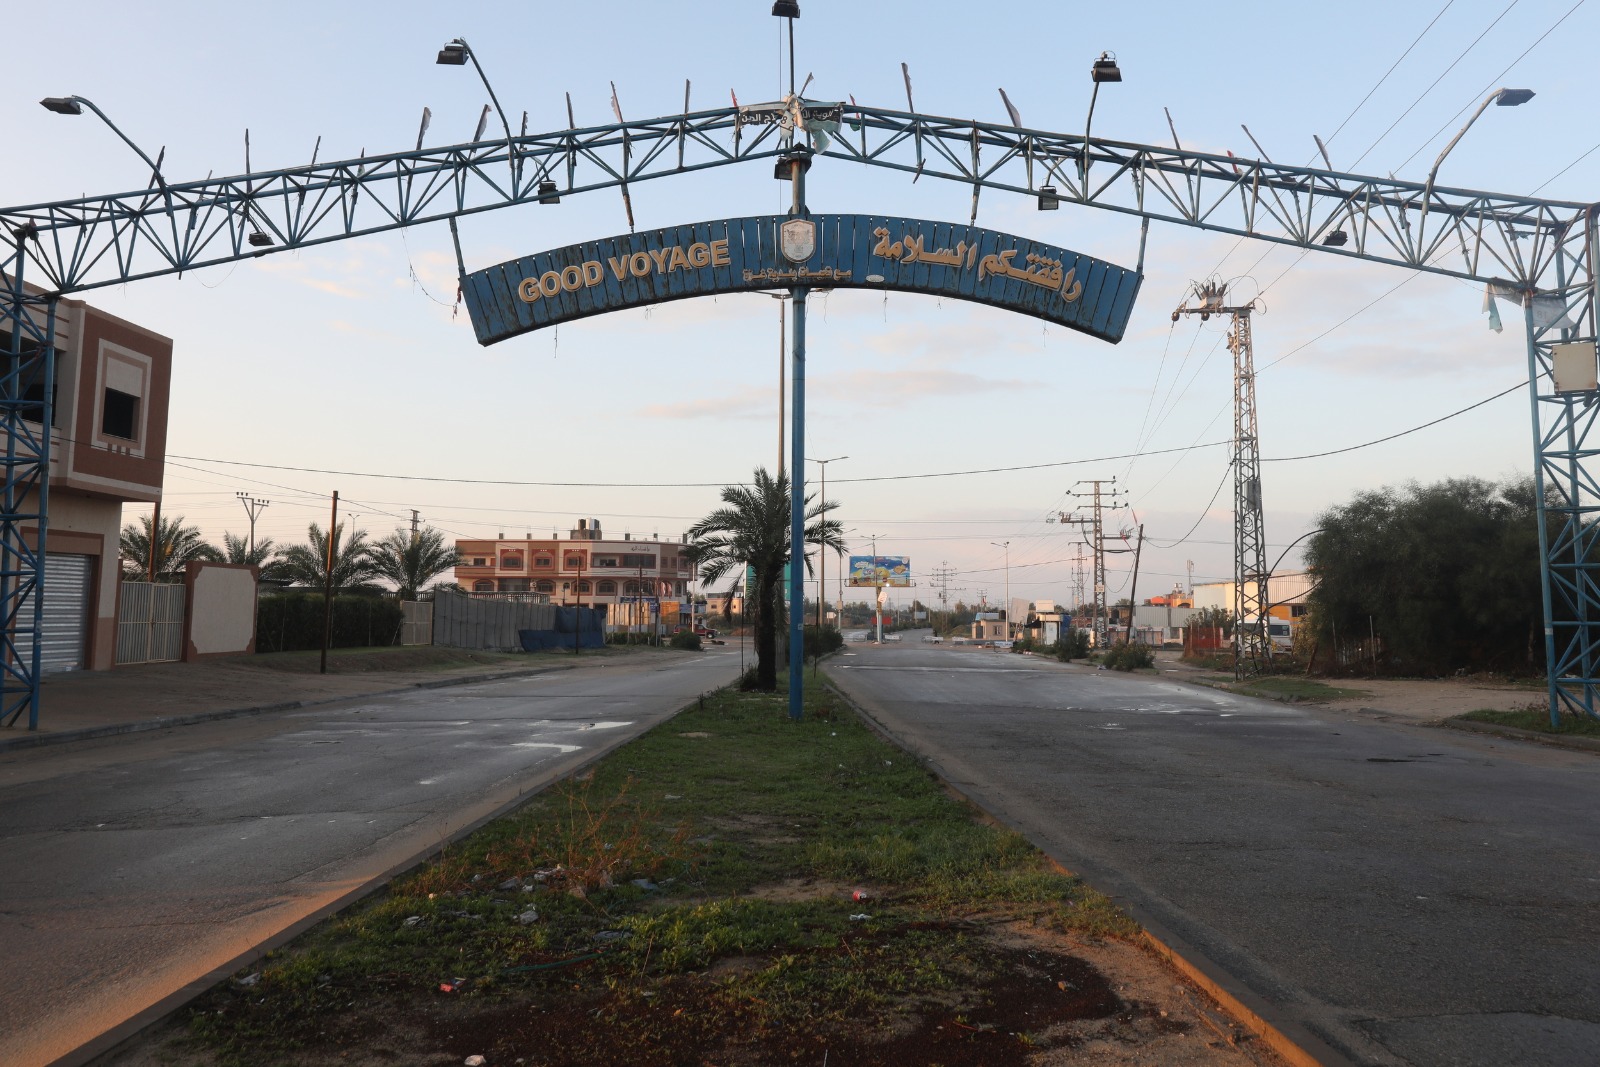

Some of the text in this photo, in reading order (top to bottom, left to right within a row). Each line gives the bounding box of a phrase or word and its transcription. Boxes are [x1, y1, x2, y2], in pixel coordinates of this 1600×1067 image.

[518, 240, 731, 302] GOOD VOYAGE
[873, 226, 1082, 302] رافقتكم السلامة
[742, 268, 767, 282] غزة
[767, 267, 798, 283] بلدية
[833, 268, 852, 281] مع
